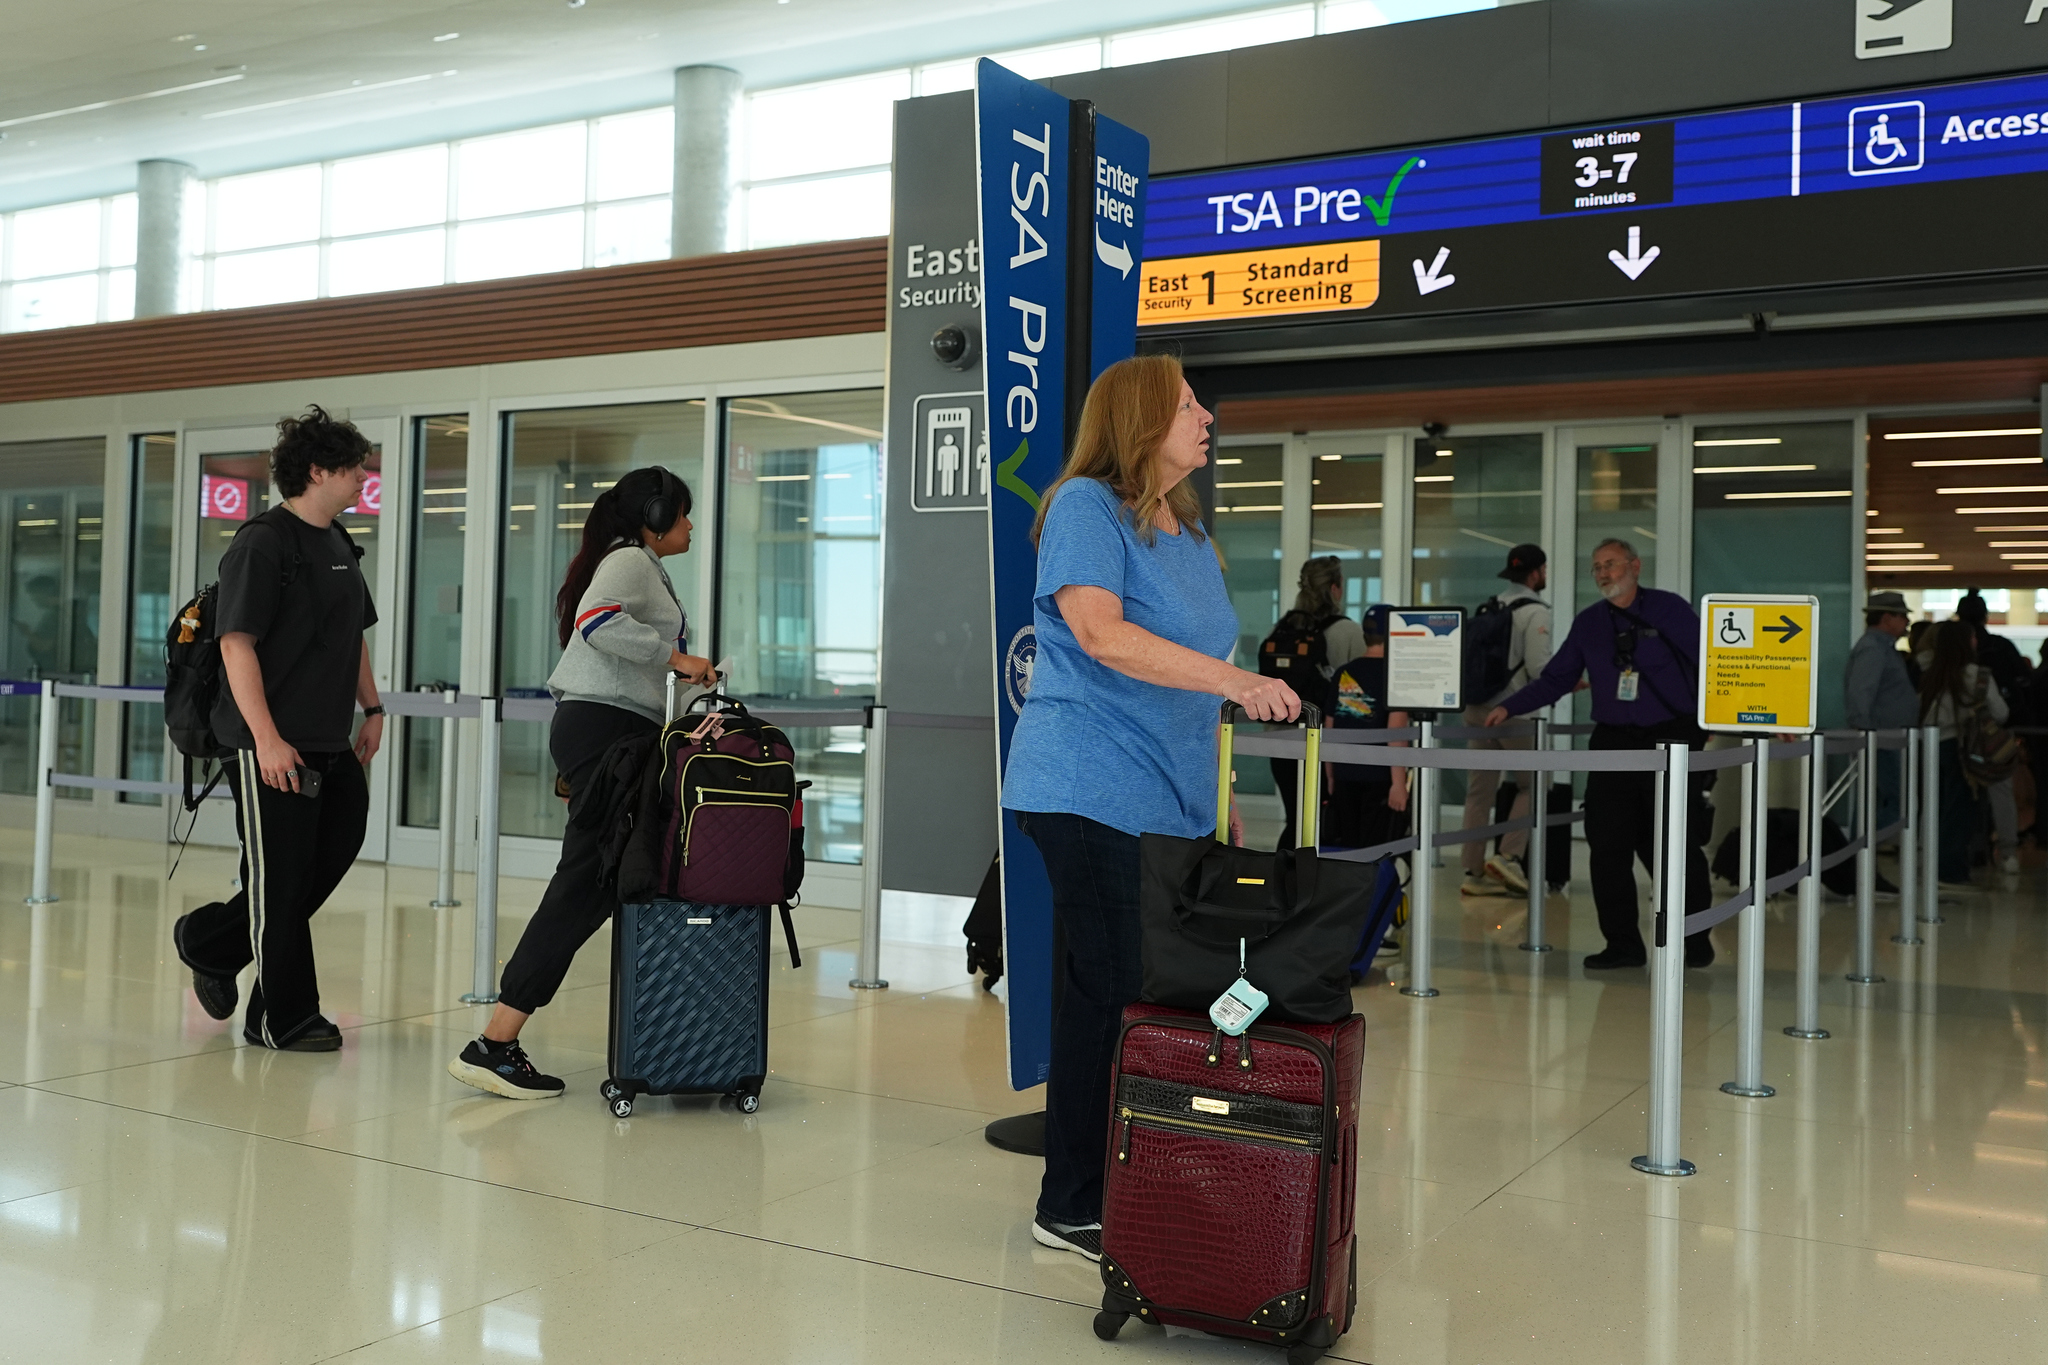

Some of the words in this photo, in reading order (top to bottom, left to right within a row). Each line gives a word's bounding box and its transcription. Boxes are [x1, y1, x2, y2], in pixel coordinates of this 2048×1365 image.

[1572, 133, 1605, 149] wait
[1607, 131, 1641, 145] time
[1097, 155, 1139, 198] Enter
[1574, 152, 1638, 188] 3-7
[1010, 122, 1050, 270] TSA
[1096, 187, 1134, 228] Here
[1208, 190, 1284, 235] TSA
[1294, 186, 1361, 227] Pre
[1574, 191, 1637, 208] minutes
[907, 239, 979, 279] East
[1248, 253, 1349, 281] Standard
[900, 281, 981, 308] Security
[1149, 273, 1189, 293] East
[1201, 270, 1215, 305] 1
[1243, 281, 1353, 306] Screening
[1145, 297, 1192, 310] Security
[1006, 295, 1047, 433] Pre
[1717, 654, 1764, 662] Accessibility
